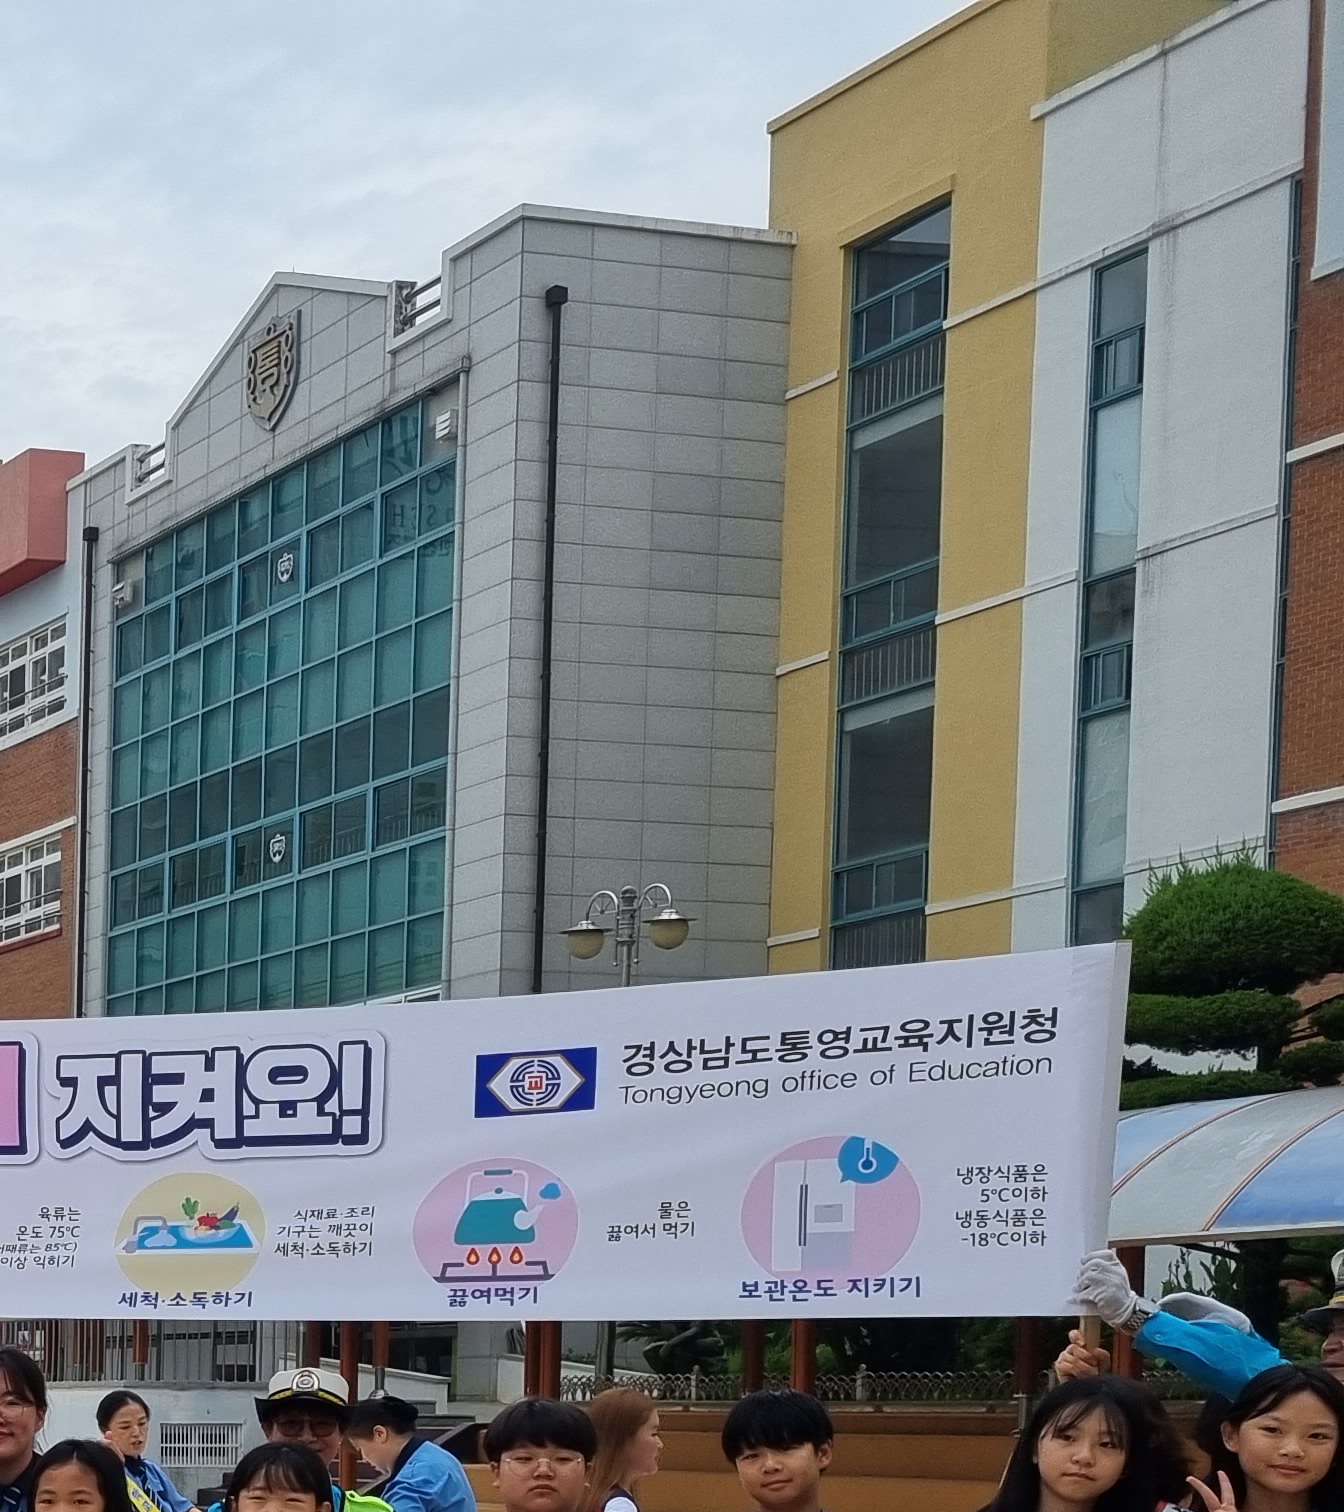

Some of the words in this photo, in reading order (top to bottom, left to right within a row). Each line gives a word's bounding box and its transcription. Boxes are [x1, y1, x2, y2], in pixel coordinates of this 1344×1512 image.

[621, 1006, 1059, 1077] 경상남도통영교육지원청
[618, 1077, 769, 1105] Tongyeong
[781, 1068, 858, 1093] office
[869, 1064, 897, 1086] of
[908, 1053, 1053, 1083] Education
[56, 1039, 373, 1151] 지켜요!
[956, 1163, 1049, 1186] 냉장식품은
[37, 1206, 81, 1222] 육류는
[657, 1200, 691, 1219] 물은
[955, 1208, 1048, 1229] 냉동식품은
[15, 1225, 44, 1241] 온도
[277, 1223, 322, 1238] 기구는
[327, 1222, 374, 1239] 깨끗이
[606, 1223, 656, 1242] 끓여서
[662, 1221, 695, 1239] 먹기
[0, 1256, 28, 1270] 이상
[33, 1255, 75, 1270] 익히기
[447, 1286, 539, 1308] 끓여먹기
[738, 1278, 838, 1302] 보관온도
[847, 1276, 921, 1299] 지키기
